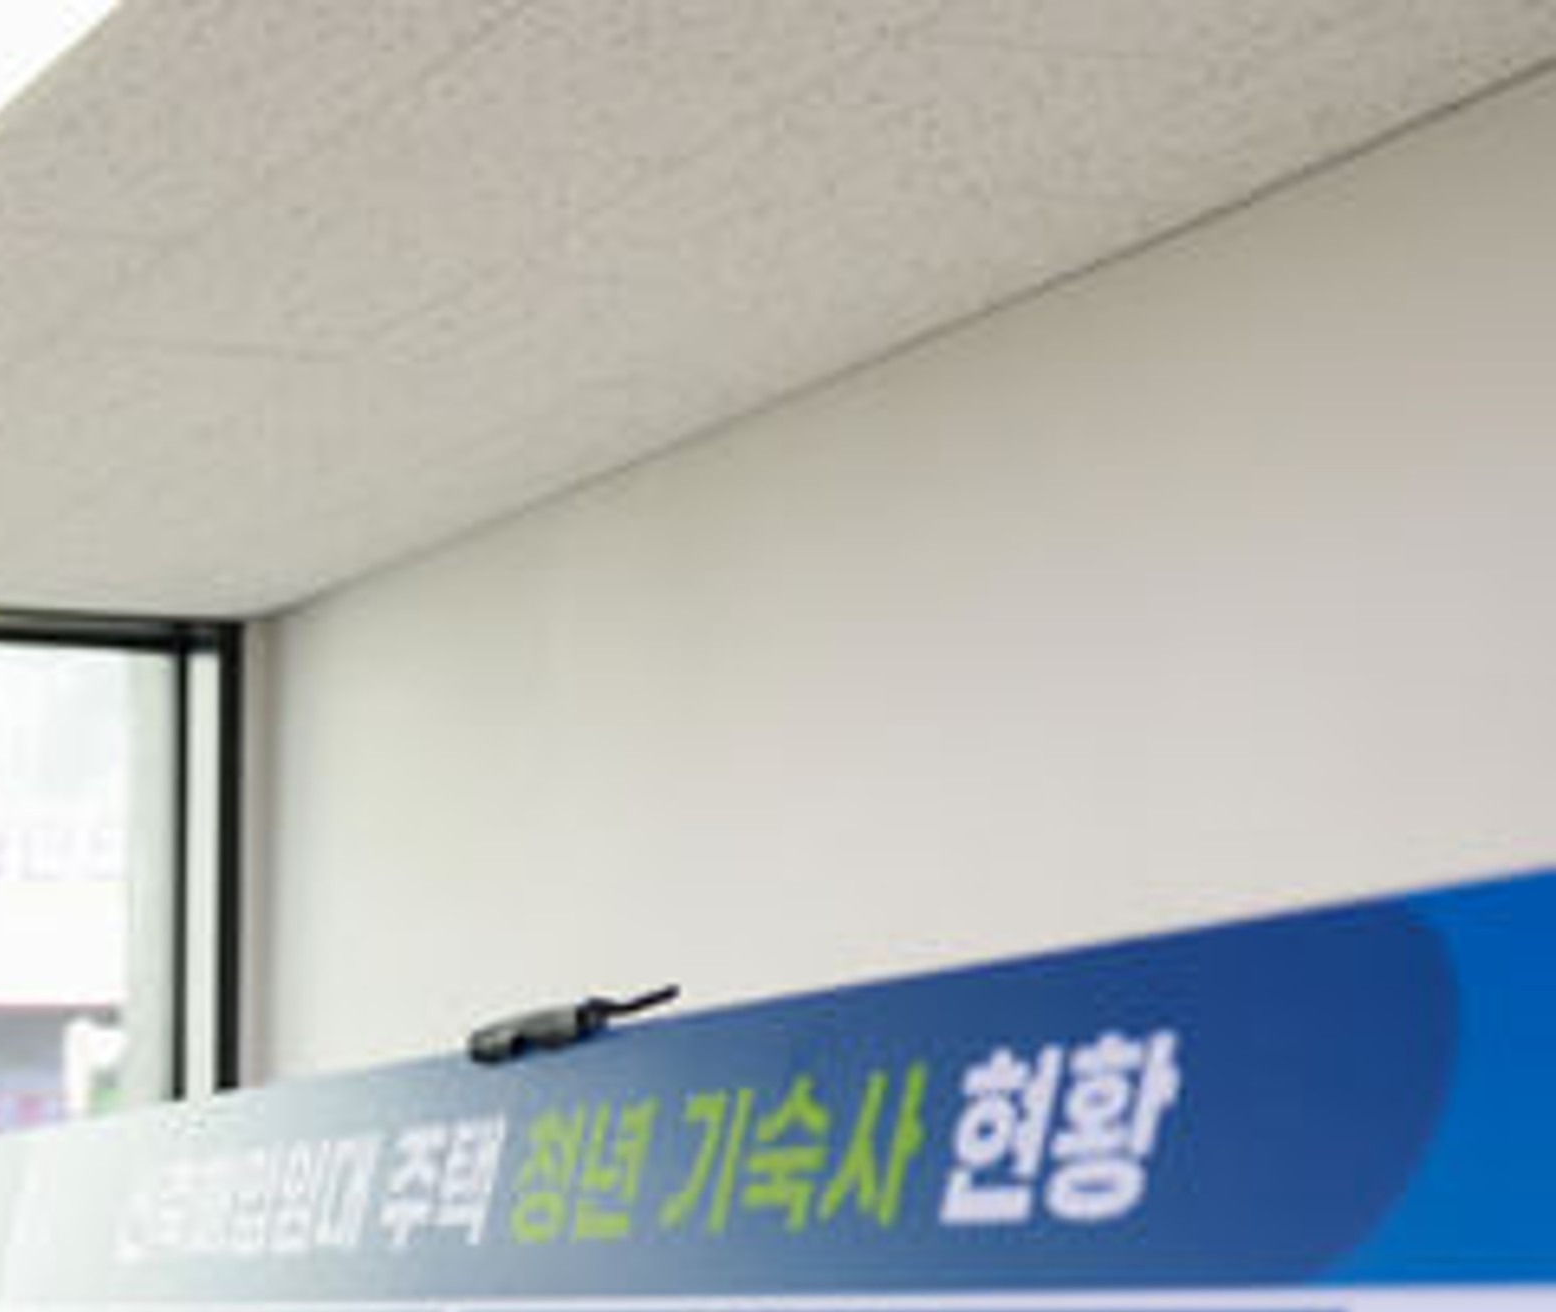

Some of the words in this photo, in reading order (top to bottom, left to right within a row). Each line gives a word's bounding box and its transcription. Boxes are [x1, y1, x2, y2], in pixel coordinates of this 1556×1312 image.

[379, 1112, 507, 1246] 주택
[509, 1098, 657, 1244] 청년
[659, 1058, 927, 1233] 기숙사
[939, 1030, 1181, 1226] 현황
